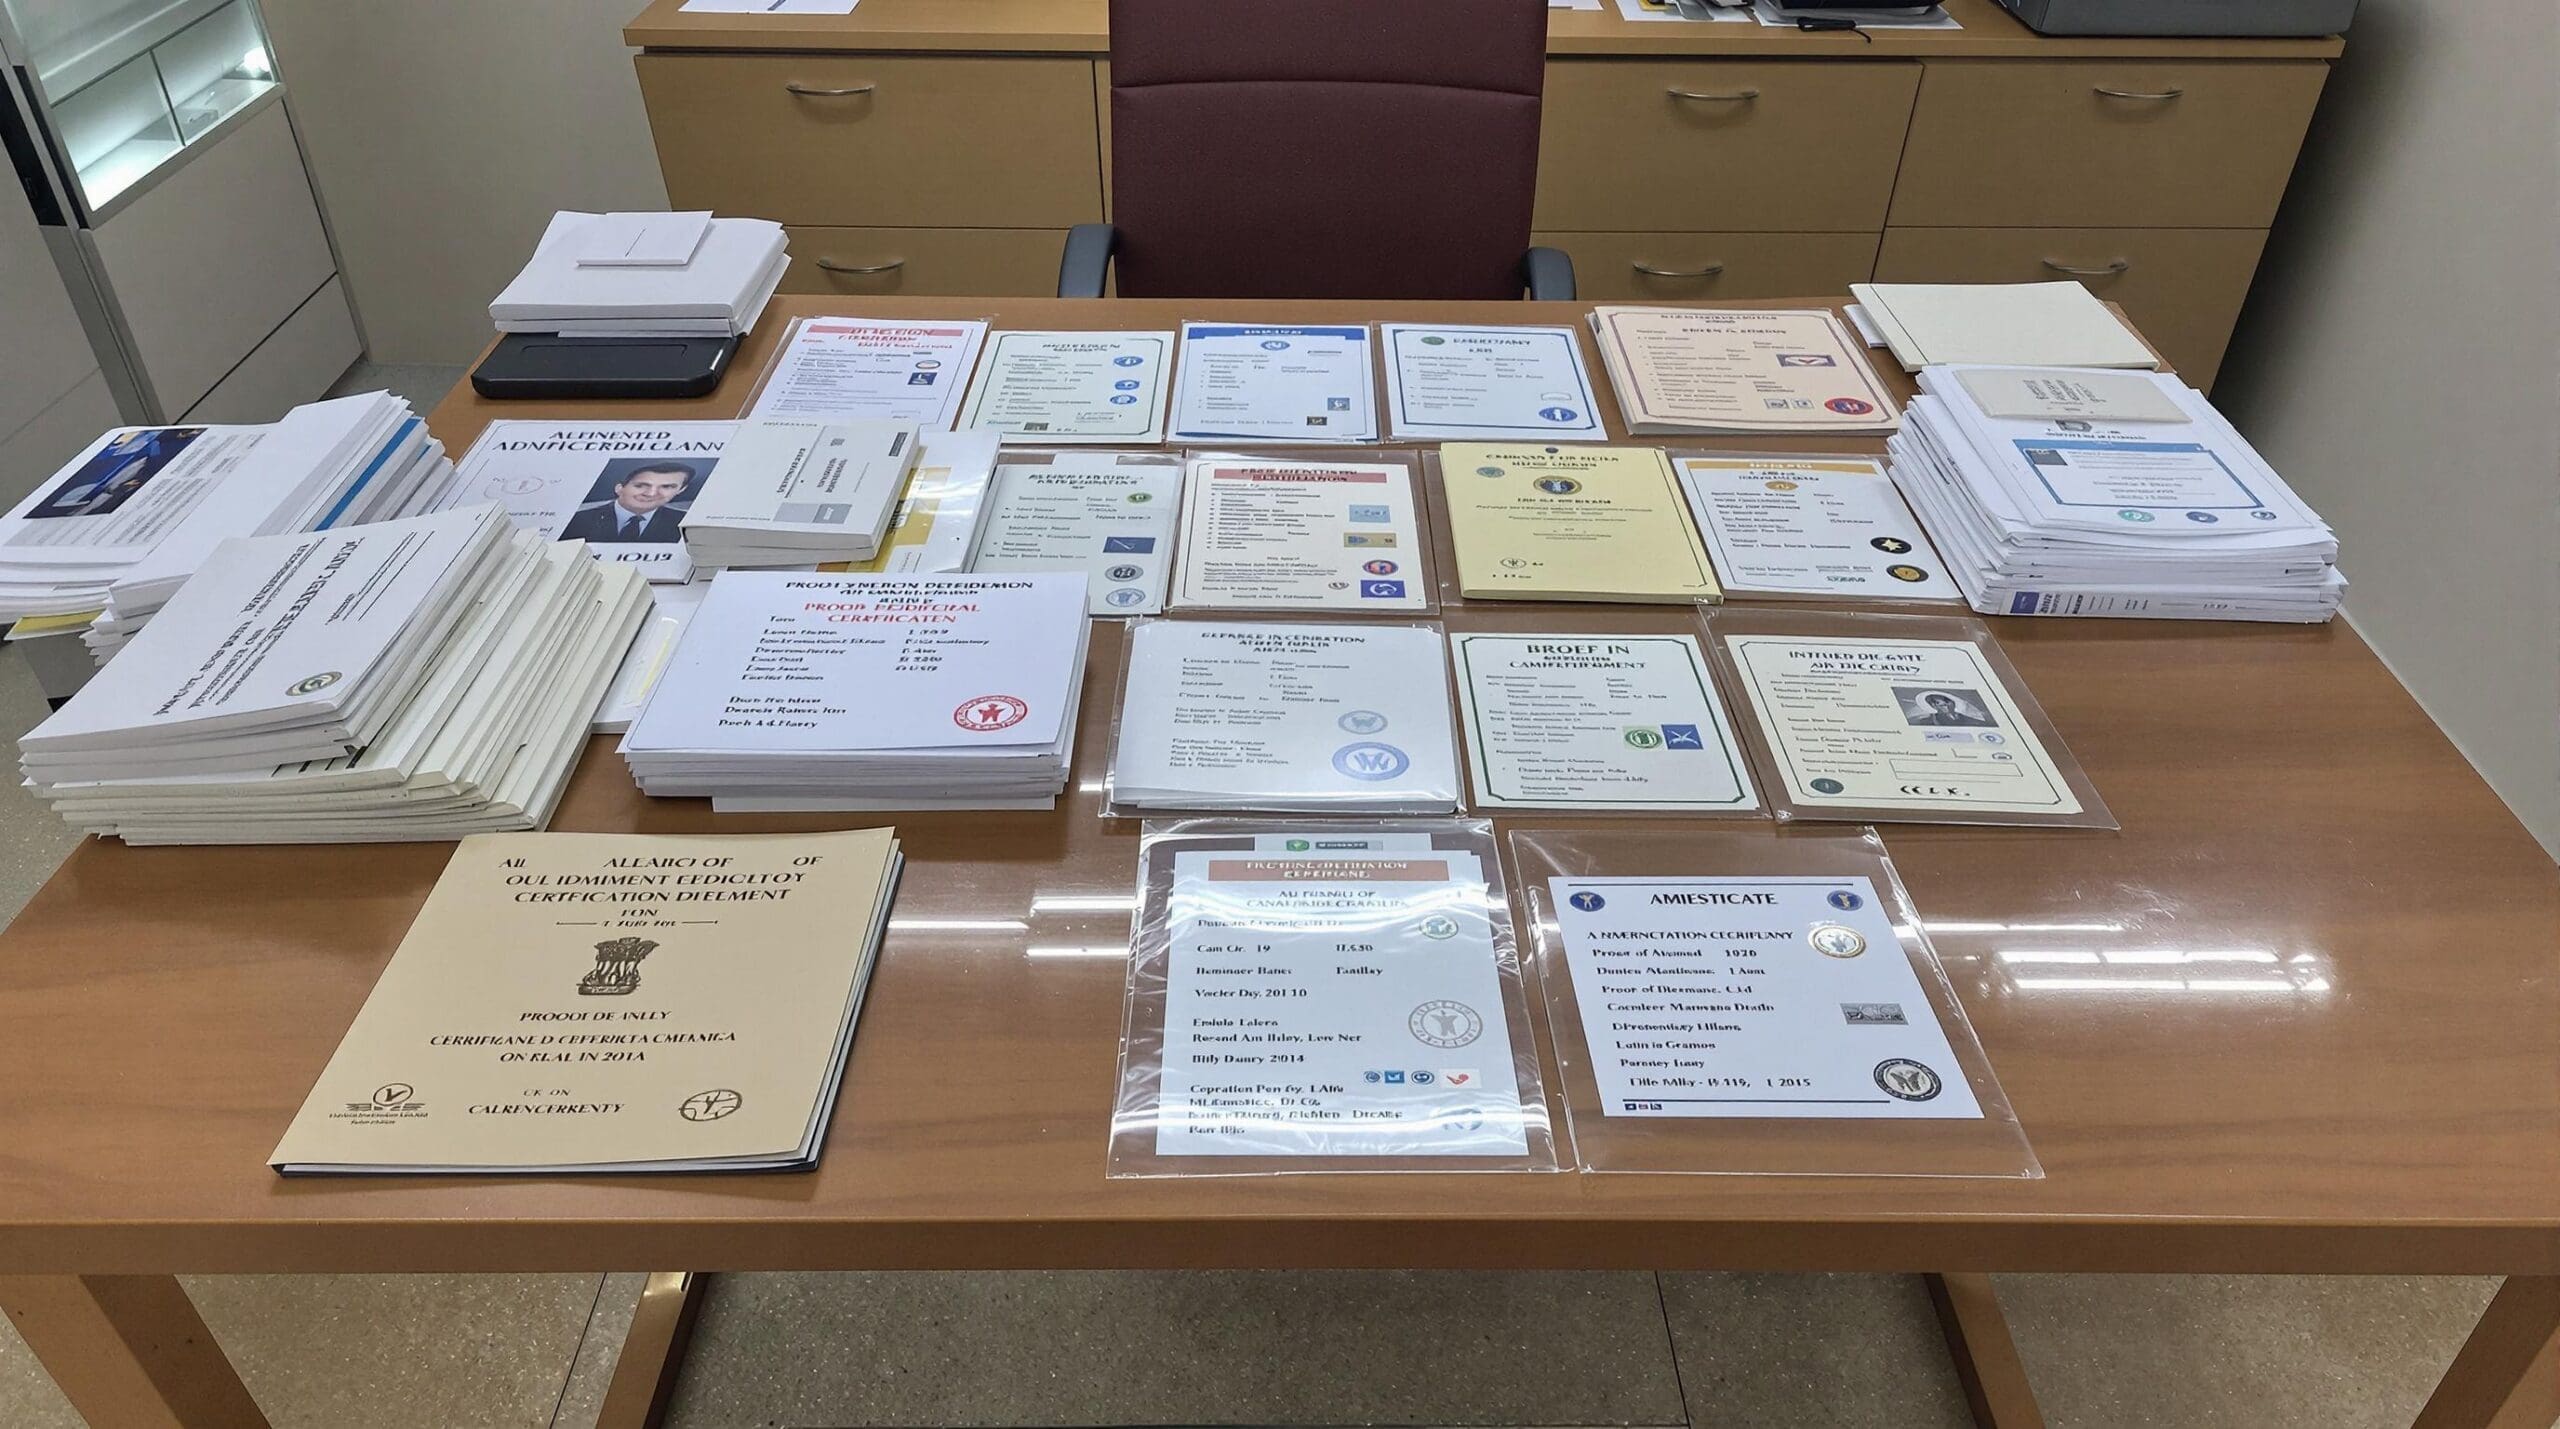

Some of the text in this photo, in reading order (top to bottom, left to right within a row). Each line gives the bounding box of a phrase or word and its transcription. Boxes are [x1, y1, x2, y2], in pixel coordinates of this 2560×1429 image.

[1607, 645, 1630, 654] IN
[792, 855, 823, 867] OF
[1649, 893, 1780, 905] AMIESTICATE
